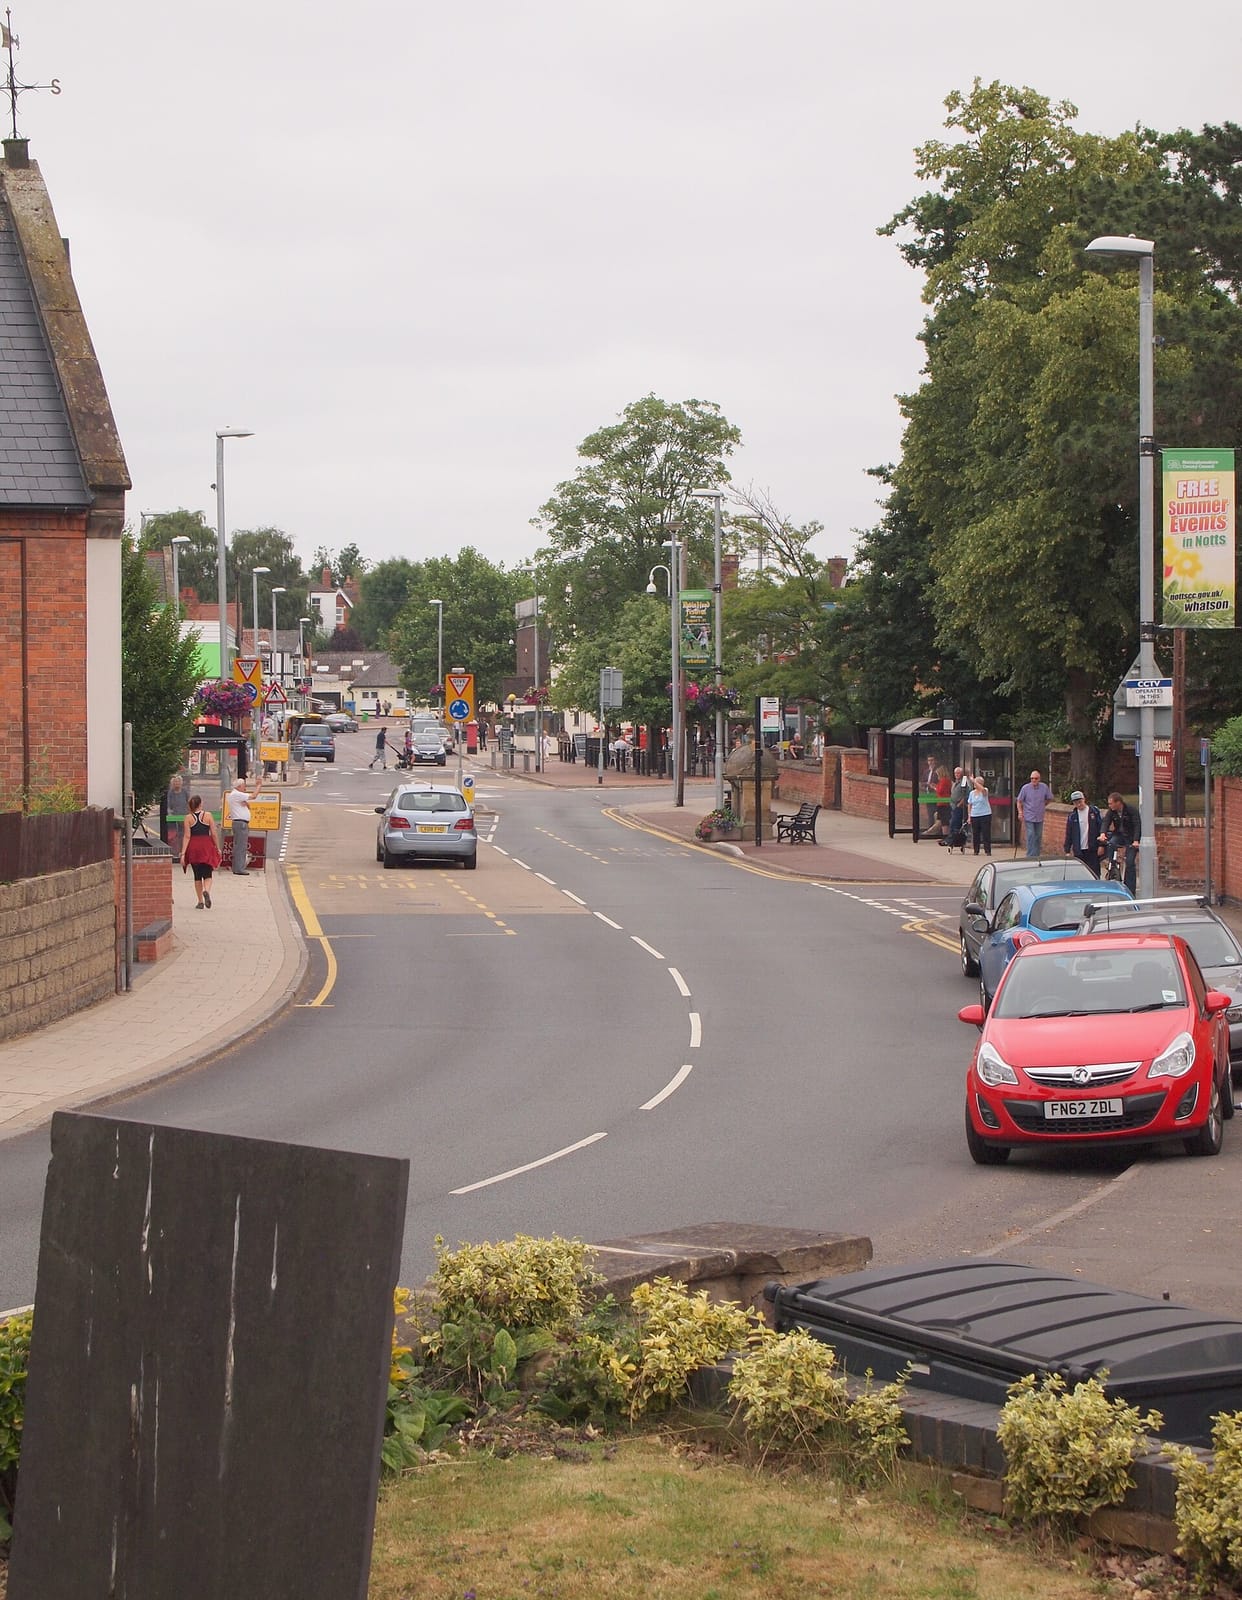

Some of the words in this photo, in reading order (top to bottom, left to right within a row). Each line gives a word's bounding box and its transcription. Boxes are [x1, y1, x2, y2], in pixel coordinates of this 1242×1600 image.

[1177, 479, 1219, 499] FREE
[1168, 498, 1229, 515] Summer
[1170, 515, 1227, 533] Events
[1182, 536, 1193, 548] in
[1195, 534, 1226, 547] Notts
[1184, 600, 1229, 612] whatson
[1155, 755, 1168, 768] HALL
[1050, 1103, 1087, 1116] FN62
[1090, 1101, 1117, 1114] ZDL
